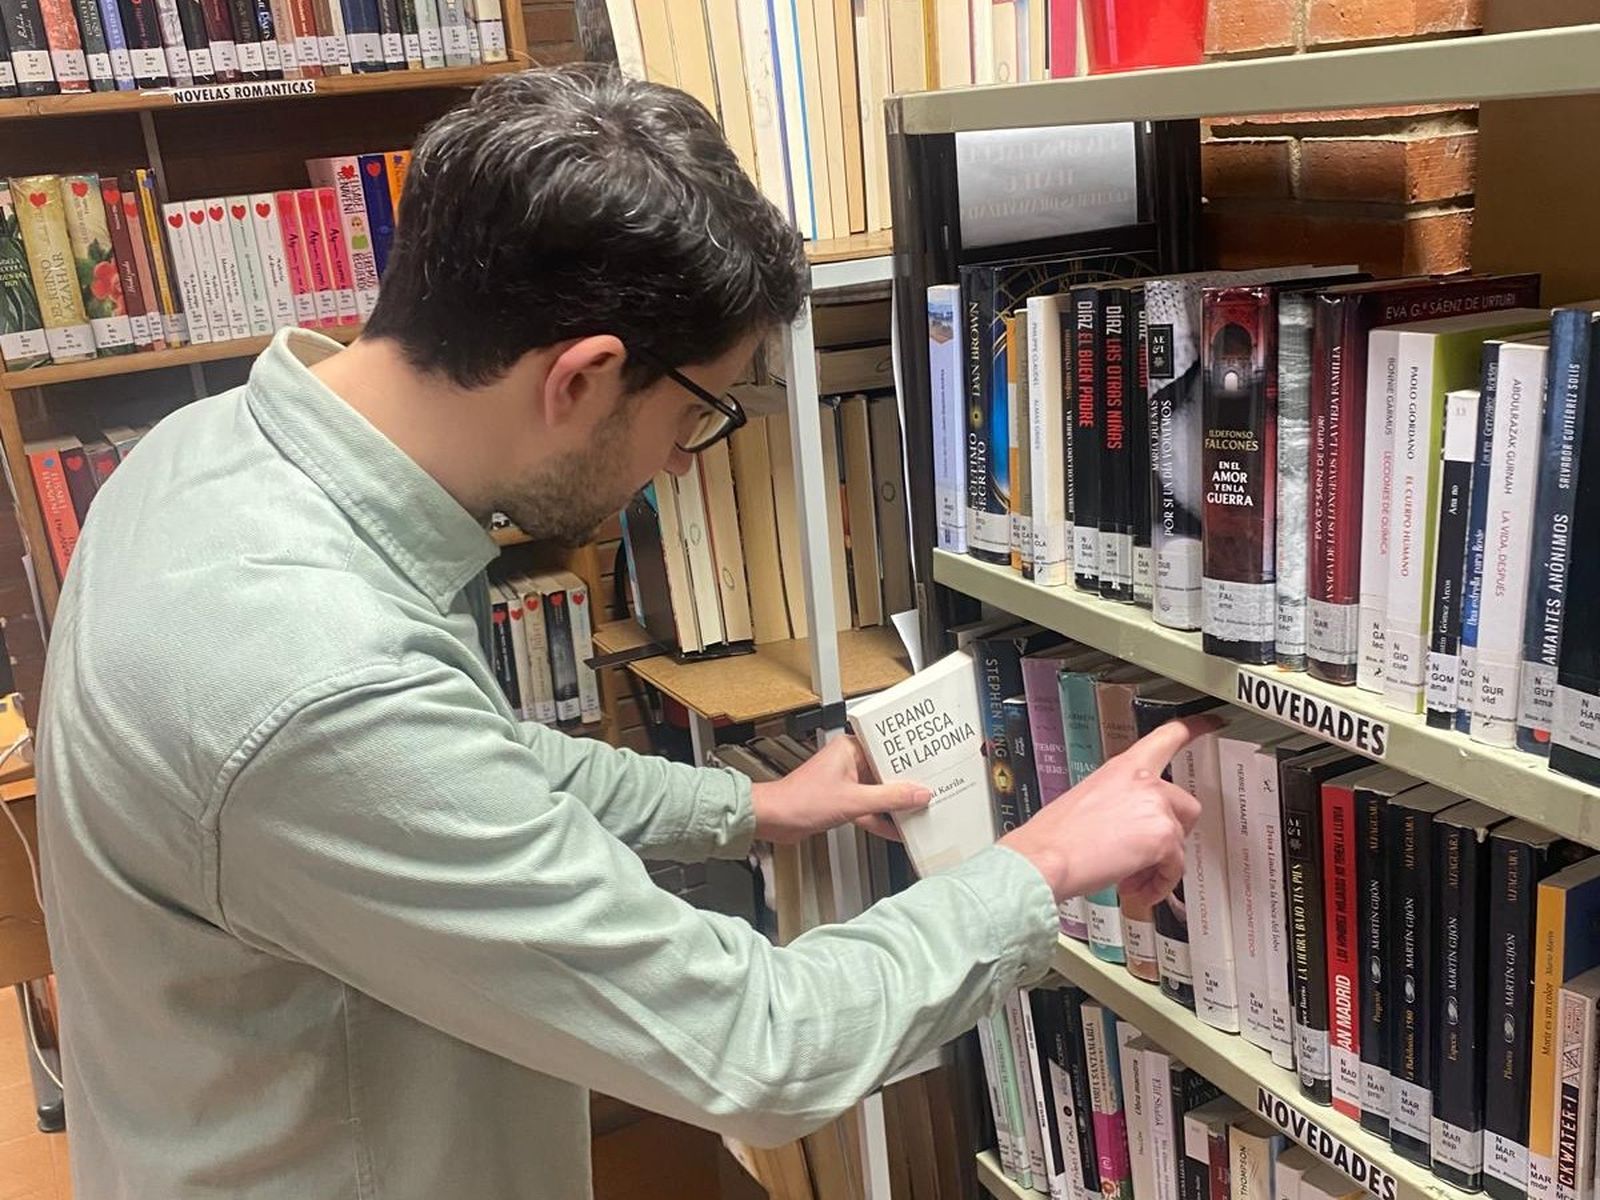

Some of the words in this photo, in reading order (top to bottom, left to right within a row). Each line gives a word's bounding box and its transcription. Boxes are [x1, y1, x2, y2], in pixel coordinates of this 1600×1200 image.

[174, 87, 230, 103] NOVELAS
[234, 81, 315, 98] ROMANTICAS
[1106, 305, 1125, 336] DÍAZ
[1386, 306, 1409, 320] EVA
[1430, 298, 1462, 314] SÁENZ
[1464, 297, 1480, 311] DE
[969, 301, 981, 361] BROWN
[1078, 331, 1092, 346] EL
[1106, 338, 1122, 361] LAS
[1078, 349, 1093, 384] BUEN
[971, 364, 981, 397] DAN
[1107, 365, 1122, 406] OTRAS
[1409, 366, 1419, 395] PAOLO
[1078, 387, 1094, 428] PADRE
[1508, 379, 1522, 449] ABDULRAZAK
[1107, 409, 1124, 450] NIÑAS
[1160, 400, 1173, 453] VOLVEMOS
[1208, 429, 1254, 439] ILDEFONSO
[1317, 415, 1326, 449] URTURI
[1407, 397, 1417, 460] GIORDANO
[1558, 444, 1573, 490] SALVADOR
[1568, 363, 1581, 391] SOLÍS
[1204, 438, 1259, 452] FALCONES
[1316, 451, 1325, 465] DE
[1211, 471, 1248, 484] AMOR
[1219, 460, 1230, 470] EN
[1231, 461, 1240, 470] EL
[1504, 450, 1516, 495] GURNAH
[1163, 480, 1173, 497] UN
[1214, 483, 1221, 491] Y
[1221, 483, 1232, 492] EN
[1233, 484, 1245, 494] LA
[1405, 476, 1414, 488] EL
[1451, 484, 1458, 495] no
[1163, 499, 1174, 514] SI
[1206, 492, 1254, 506] GUERRA
[1382, 501, 1390, 512] DE
[1402, 490, 1413, 528] CUERPO
[1449, 496, 1458, 516] Ana
[1164, 516, 1175, 537] POR
[1502, 511, 1511, 525] LA
[1314, 524, 1323, 540] EVA
[1329, 521, 1337, 543] LOS
[1328, 547, 1336, 561] DE
[1400, 532, 1411, 577] HUMANO
[1544, 513, 1570, 594] ANÓNIMOS
[1218, 593, 1234, 601] FAL
[1442, 579, 1451, 602] Arcos
[1278, 615, 1294, 623] FER
[1439, 605, 1449, 633] Gómez
[1541, 598, 1561, 665] AMANTES
[1393, 652, 1409, 662] GIO
[985, 658, 1003, 719] STEPHEN
[1430, 683, 1448, 692] ana
[1431, 672, 1455, 684] GOM
[1482, 685, 1505, 696] GUR
[1481, 695, 1496, 705] vid
[1534, 688, 1555, 698] GUT
[875, 698, 936, 737] VERANO
[1237, 672, 1385, 756] NOVEDADES
[883, 735, 906, 756] DE
[906, 712, 954, 746] PESCA
[991, 722, 1008, 758] KING
[890, 753, 912, 774] EN
[913, 722, 976, 764] LAPONIA
[938, 778, 965, 795] Karila
[1237, 763, 1245, 793] PIERRE
[1239, 793, 1249, 837] LEMAITRE
[1368, 799, 1378, 852] ALFAGUARA
[1266, 824, 1275, 850] Elvira
[1405, 815, 1415, 870] ALFAGUARA
[1268, 851, 1277, 878] Lindo
[1292, 863, 1302, 885] PIES
[1449, 833, 1460, 889] ALFAGUARA
[1506, 848, 1518, 903] ALFAGUARA
[1293, 885, 1303, 905] TUS
[1371, 880, 1380, 911] GIJÓN
[1293, 905, 1305, 932] BAJO
[1405, 897, 1415, 929] GIJÓN
[1371, 911, 1380, 951] MARTÍN
[1448, 916, 1459, 950] GIJÓN
[1294, 932, 1307, 967] TIERRA
[1405, 930, 1414, 969] MARTÍN
[1505, 932, 1516, 967] GIJÓN
[1298, 967, 1308, 982] LA
[1448, 950, 1457, 991] MARTÍN
[1504, 967, 1515, 1007] MARTÍN
[1545, 983, 1554, 1006] color
[1334, 974, 1351, 1028] MADRID
[1545, 1006, 1553, 1019] un
[1544, 1019, 1552, 1032] es
[1340, 1067, 1357, 1079] MAD
[1367, 1081, 1385, 1093] MAR
[1401, 1097, 1420, 1110] MAR
[1257, 1087, 1396, 1200] NOVEDADES
[1442, 1130, 1461, 1142] MAR
[1495, 1144, 1516, 1159] MAR
[1495, 1153, 1508, 1164] pla
[1239, 1144, 1249, 1196] THOMPSON
[1530, 1171, 1552, 1185] MAR
